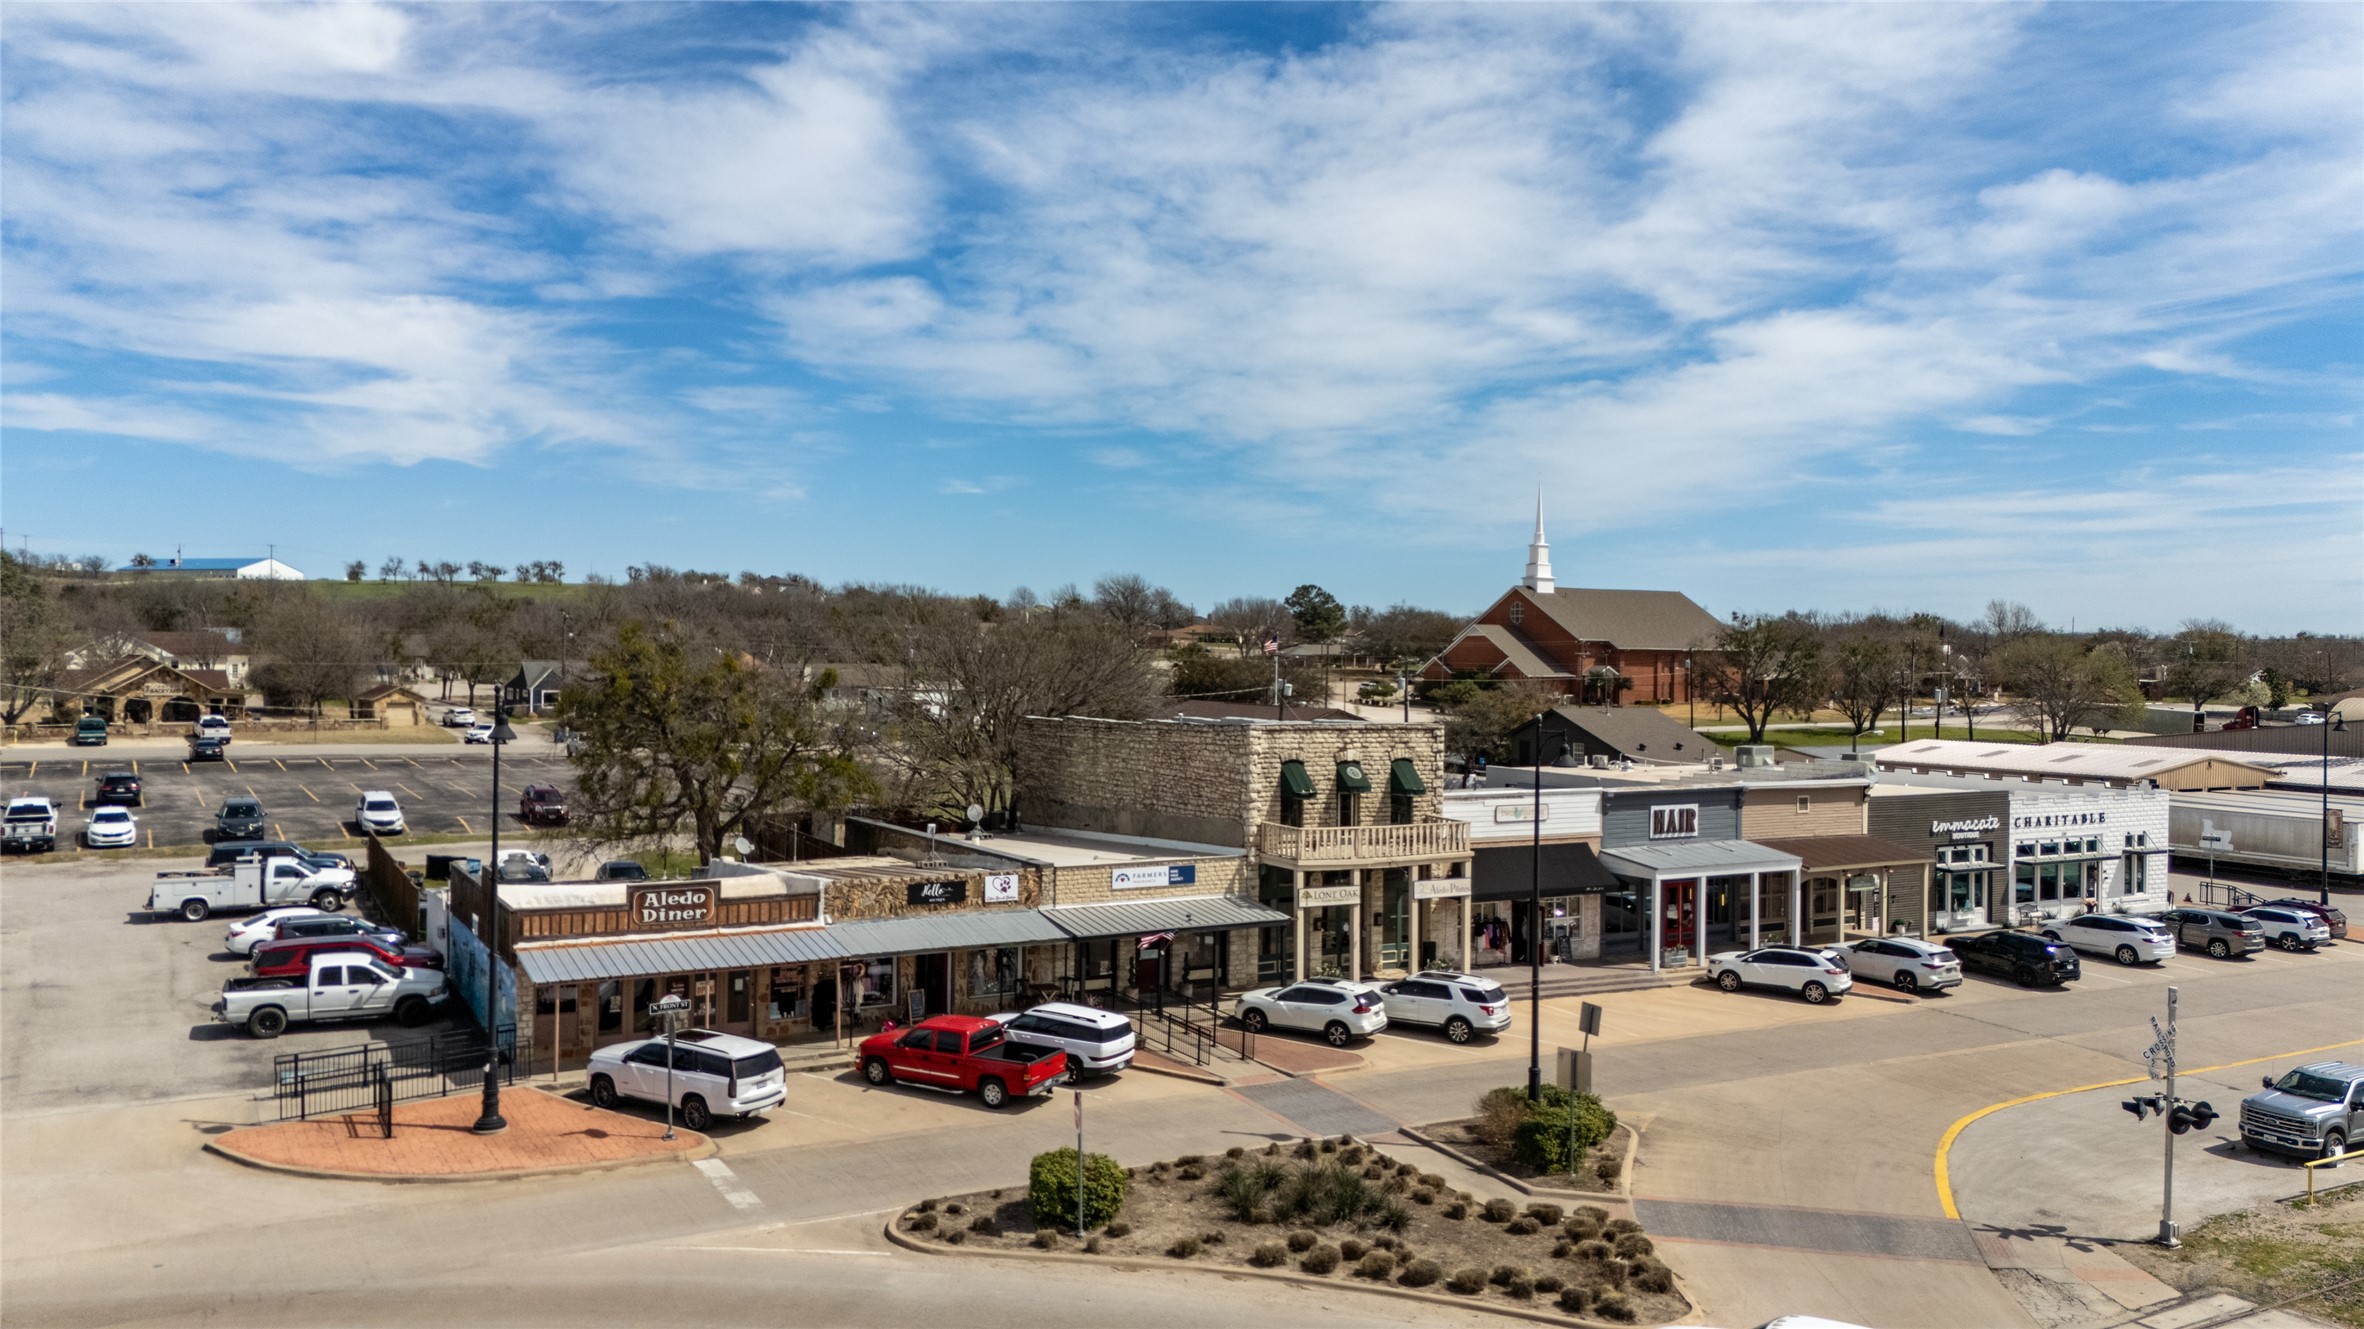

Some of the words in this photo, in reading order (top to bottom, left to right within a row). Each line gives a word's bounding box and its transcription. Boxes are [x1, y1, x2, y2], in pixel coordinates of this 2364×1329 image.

[1653, 808, 1697, 834] HAIR
[1932, 814, 2000, 833] emmacate
[2014, 812, 2105, 828] CHARITABLE
[1952, 831, 1980, 840] BOUTIQUE
[1132, 871, 1168, 879] FARMERS
[921, 883, 946, 897] Hello
[1313, 890, 1337, 900] LONE
[1340, 889, 1359, 898] OAK
[644, 891, 706, 907] Aledo
[641, 908, 707, 923] Diner
[660, 1001, 680, 1010] FRONT
[2142, 1024, 2176, 1059] CROSSING
